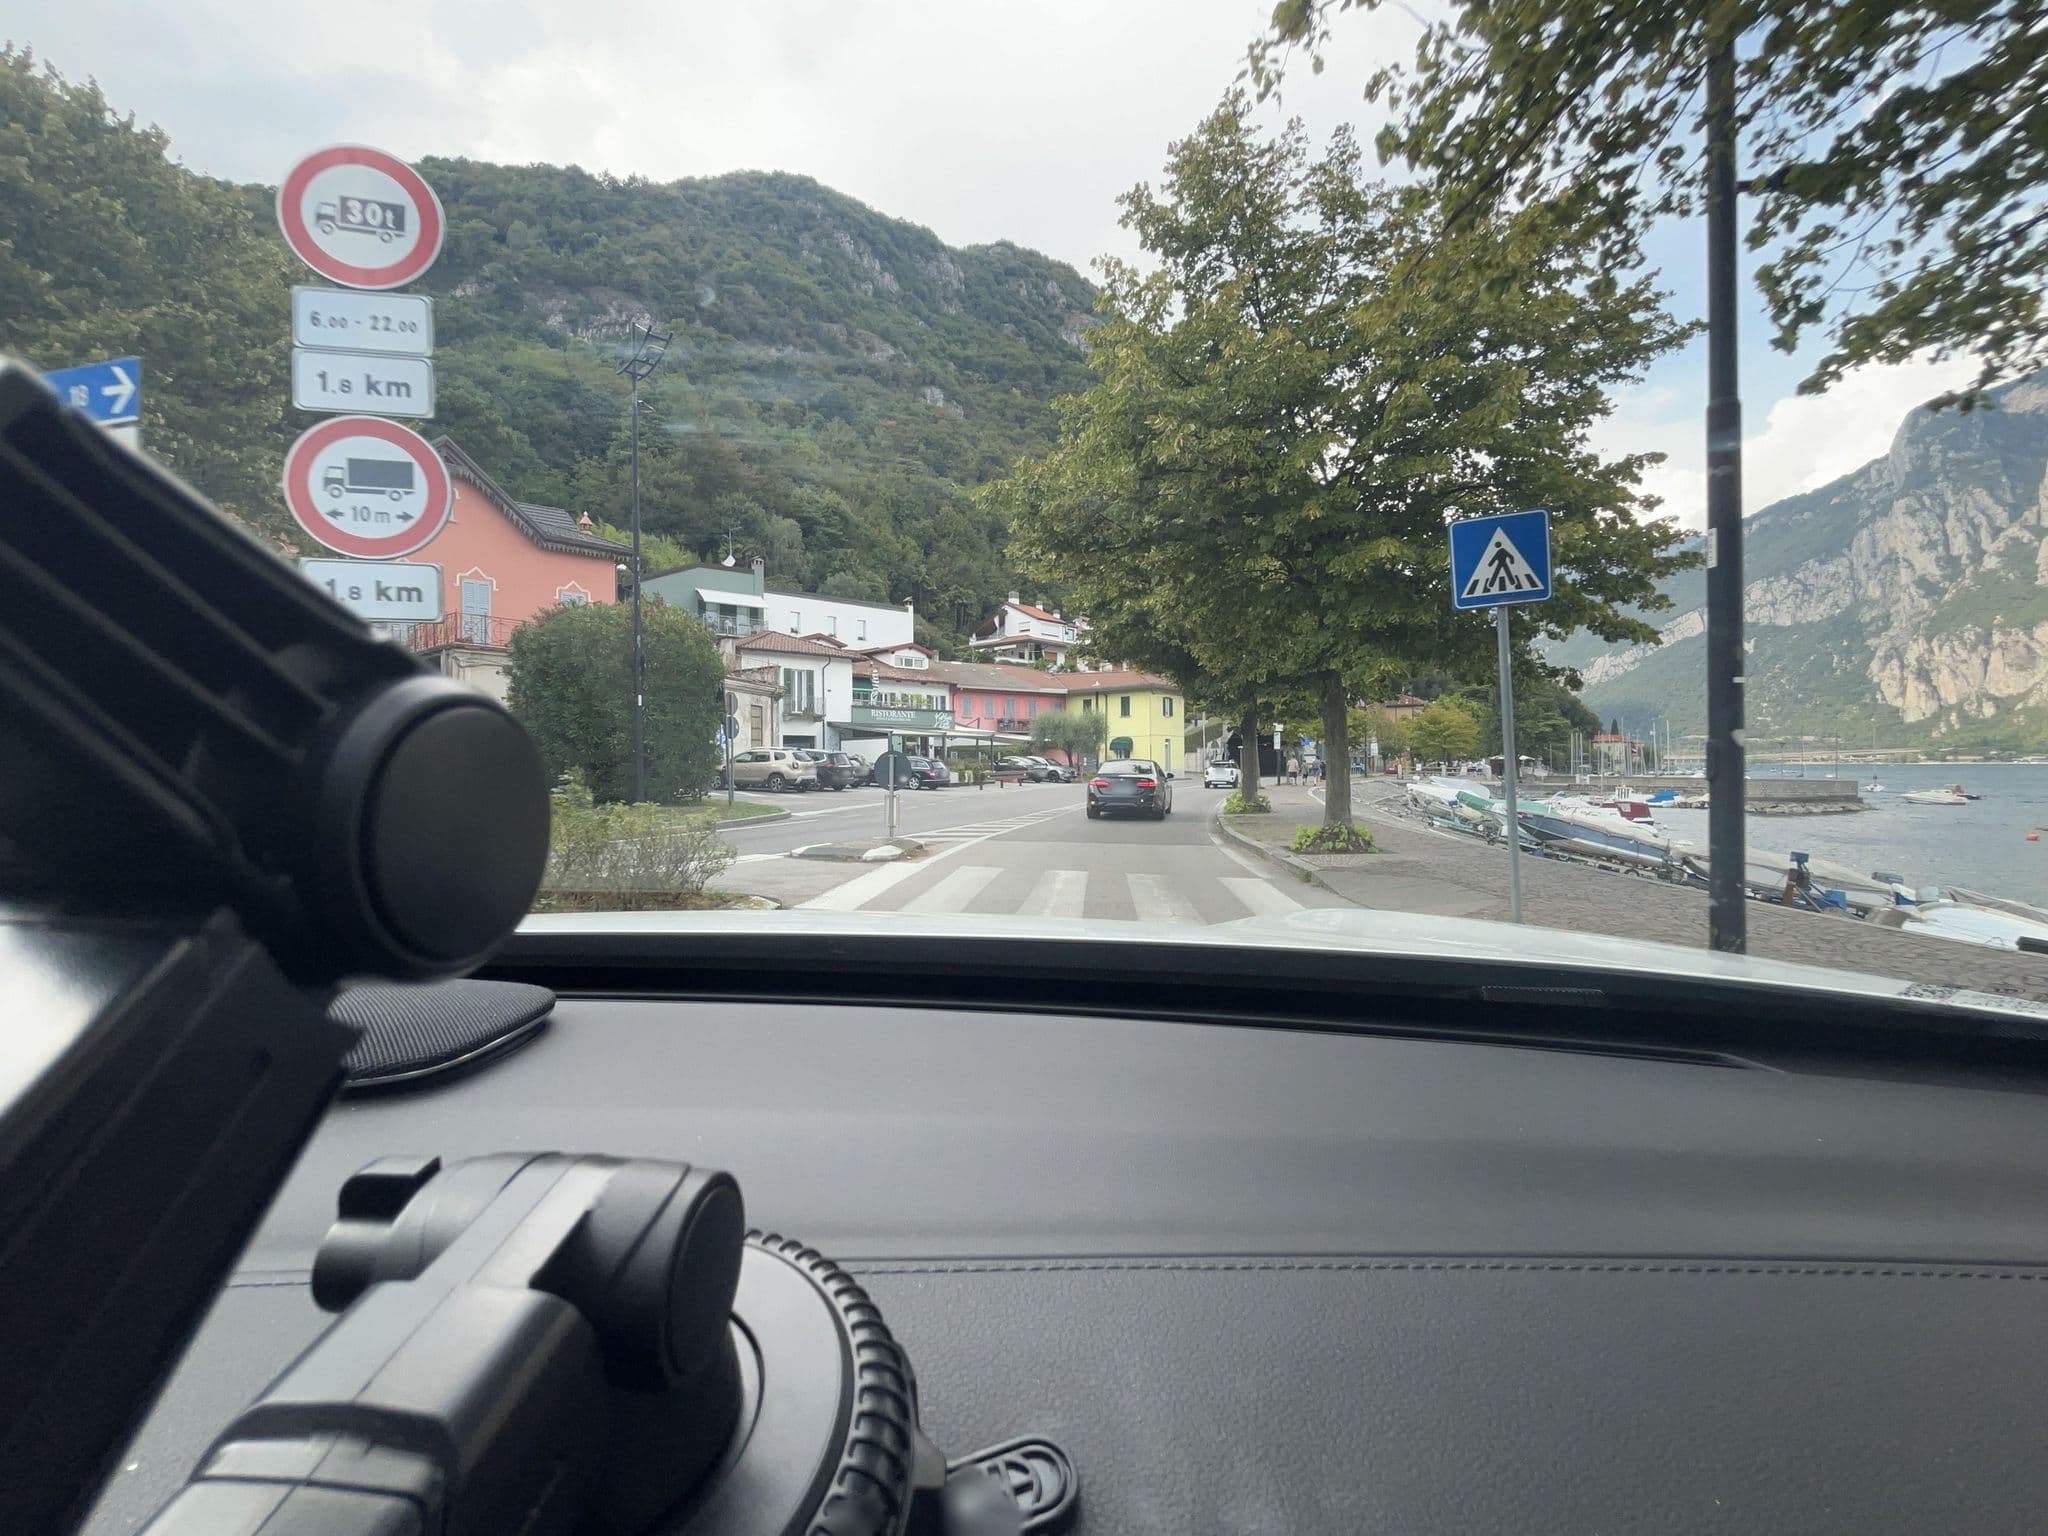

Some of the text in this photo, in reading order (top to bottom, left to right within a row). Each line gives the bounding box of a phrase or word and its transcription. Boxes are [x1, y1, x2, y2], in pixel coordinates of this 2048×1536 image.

[347, 199, 396, 229] 30t
[310, 310, 348, 329] 6.00
[369, 314, 417, 334] 22.00
[316, 370, 411, 398] 1.8 km
[375, 580, 424, 603] km
[871, 709, 917, 720] RISTORANTE
